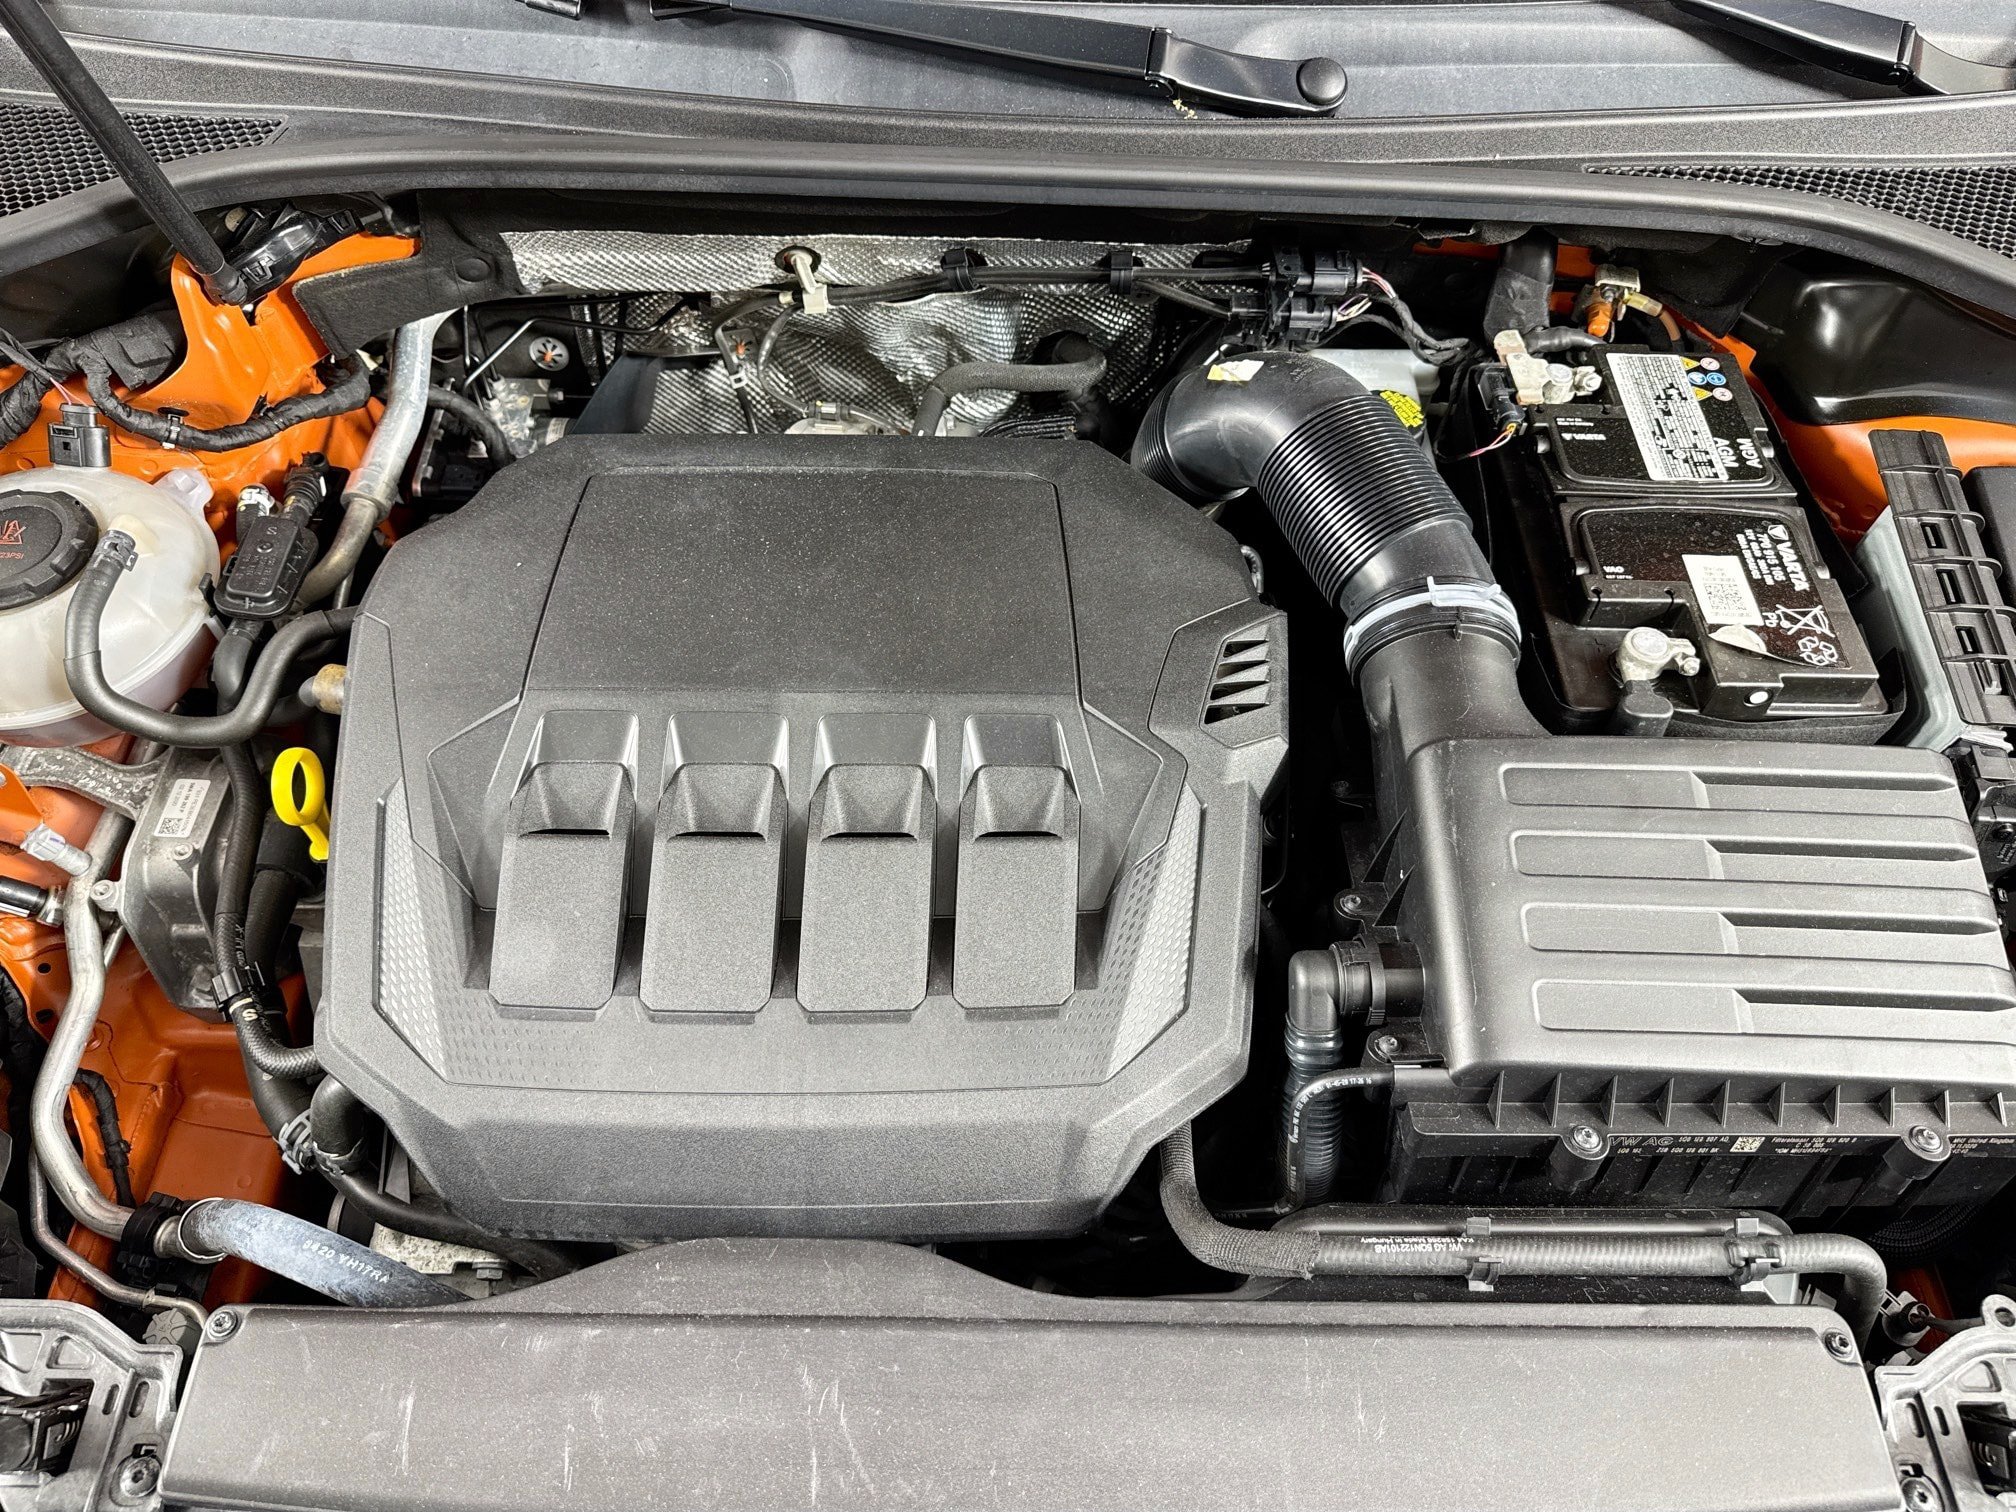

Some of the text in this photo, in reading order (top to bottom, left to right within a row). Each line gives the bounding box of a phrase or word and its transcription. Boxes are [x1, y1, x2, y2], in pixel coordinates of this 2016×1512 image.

[1712, 436, 1739, 468] AGM
[1736, 438, 1763, 468] AGM
[1762, 550, 1779, 564] 915
[1770, 566, 1786, 582] 105
[1776, 541, 1810, 591] VARTA
[1762, 612, 1779, 628] Pb
[242, 1008, 258, 1021] S
[1609, 1136, 1642, 1146] VW
[1642, 1136, 1674, 1146] AG
